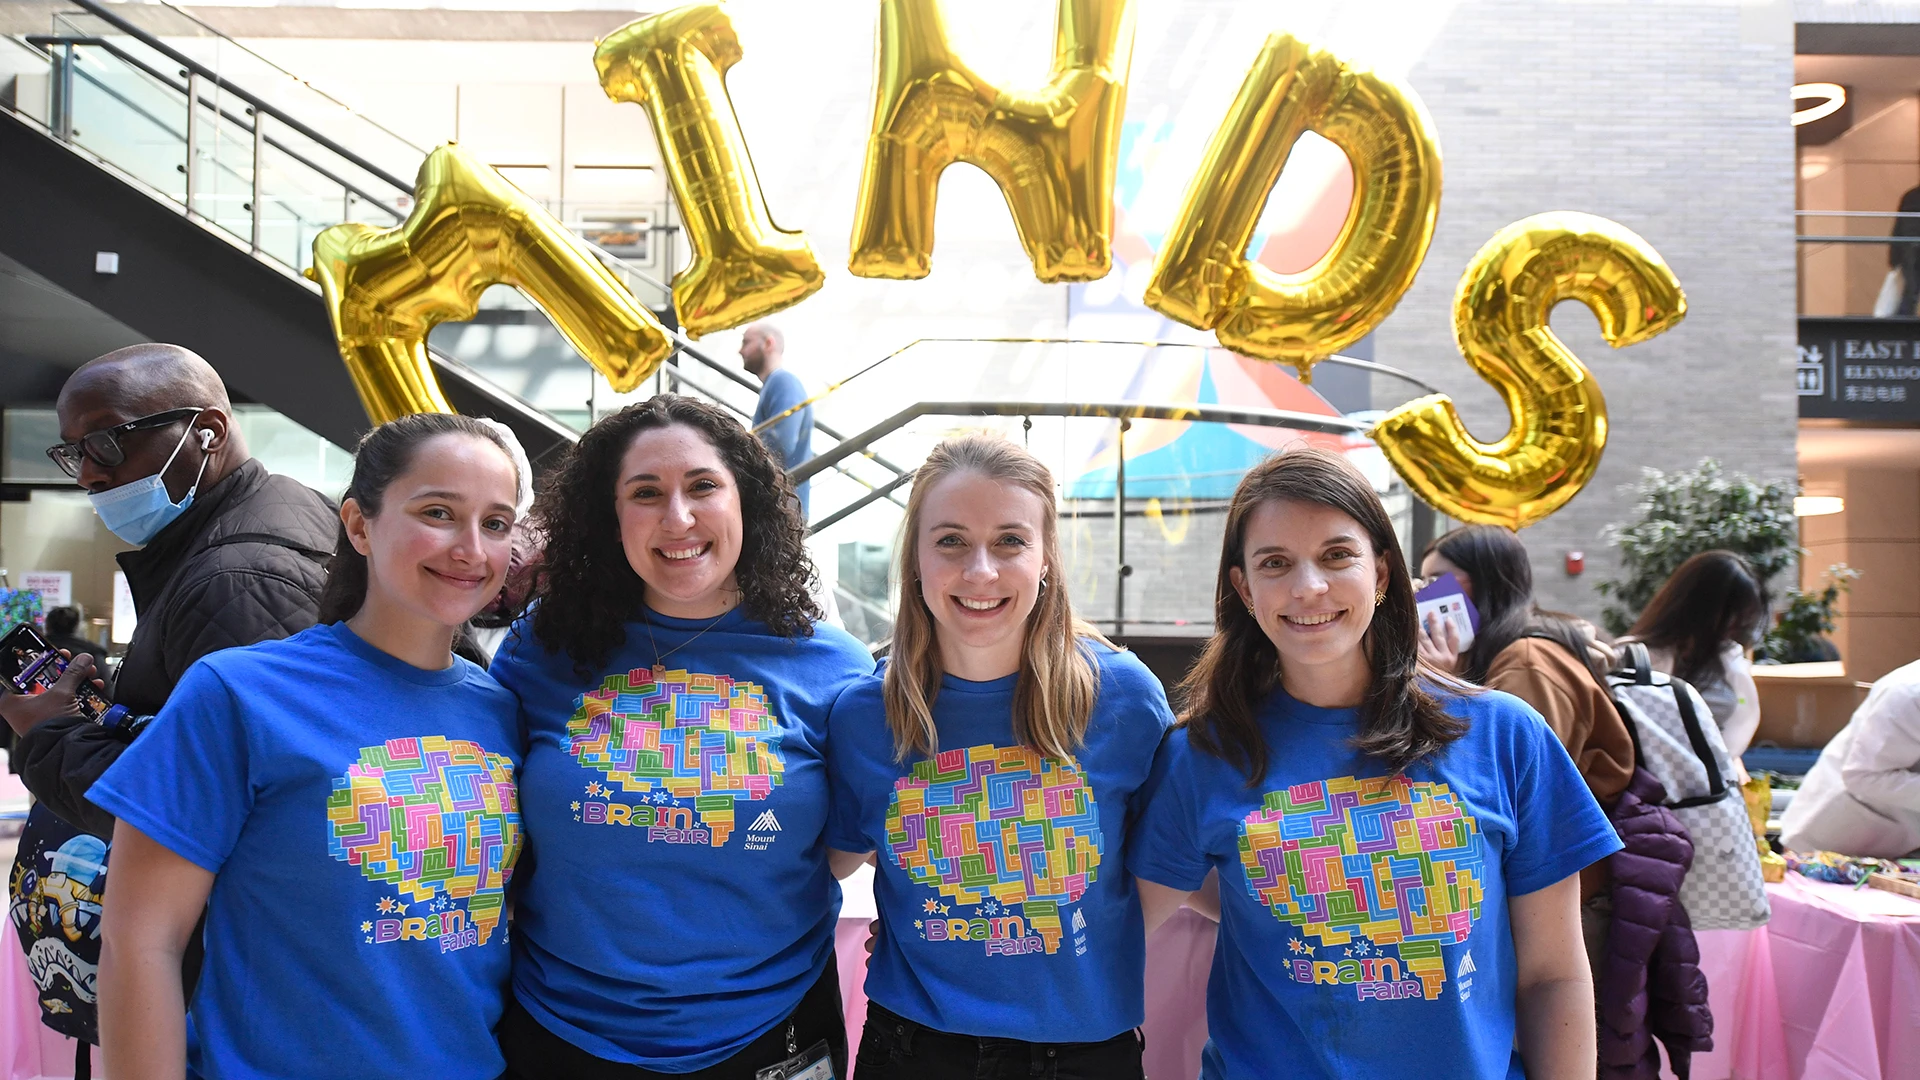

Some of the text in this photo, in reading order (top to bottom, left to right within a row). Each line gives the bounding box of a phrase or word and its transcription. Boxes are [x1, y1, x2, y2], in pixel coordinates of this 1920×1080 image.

[1844, 340, 1908, 359] EAST
[745, 834, 776, 843] Mount
[743, 842, 769, 851] Sinai
